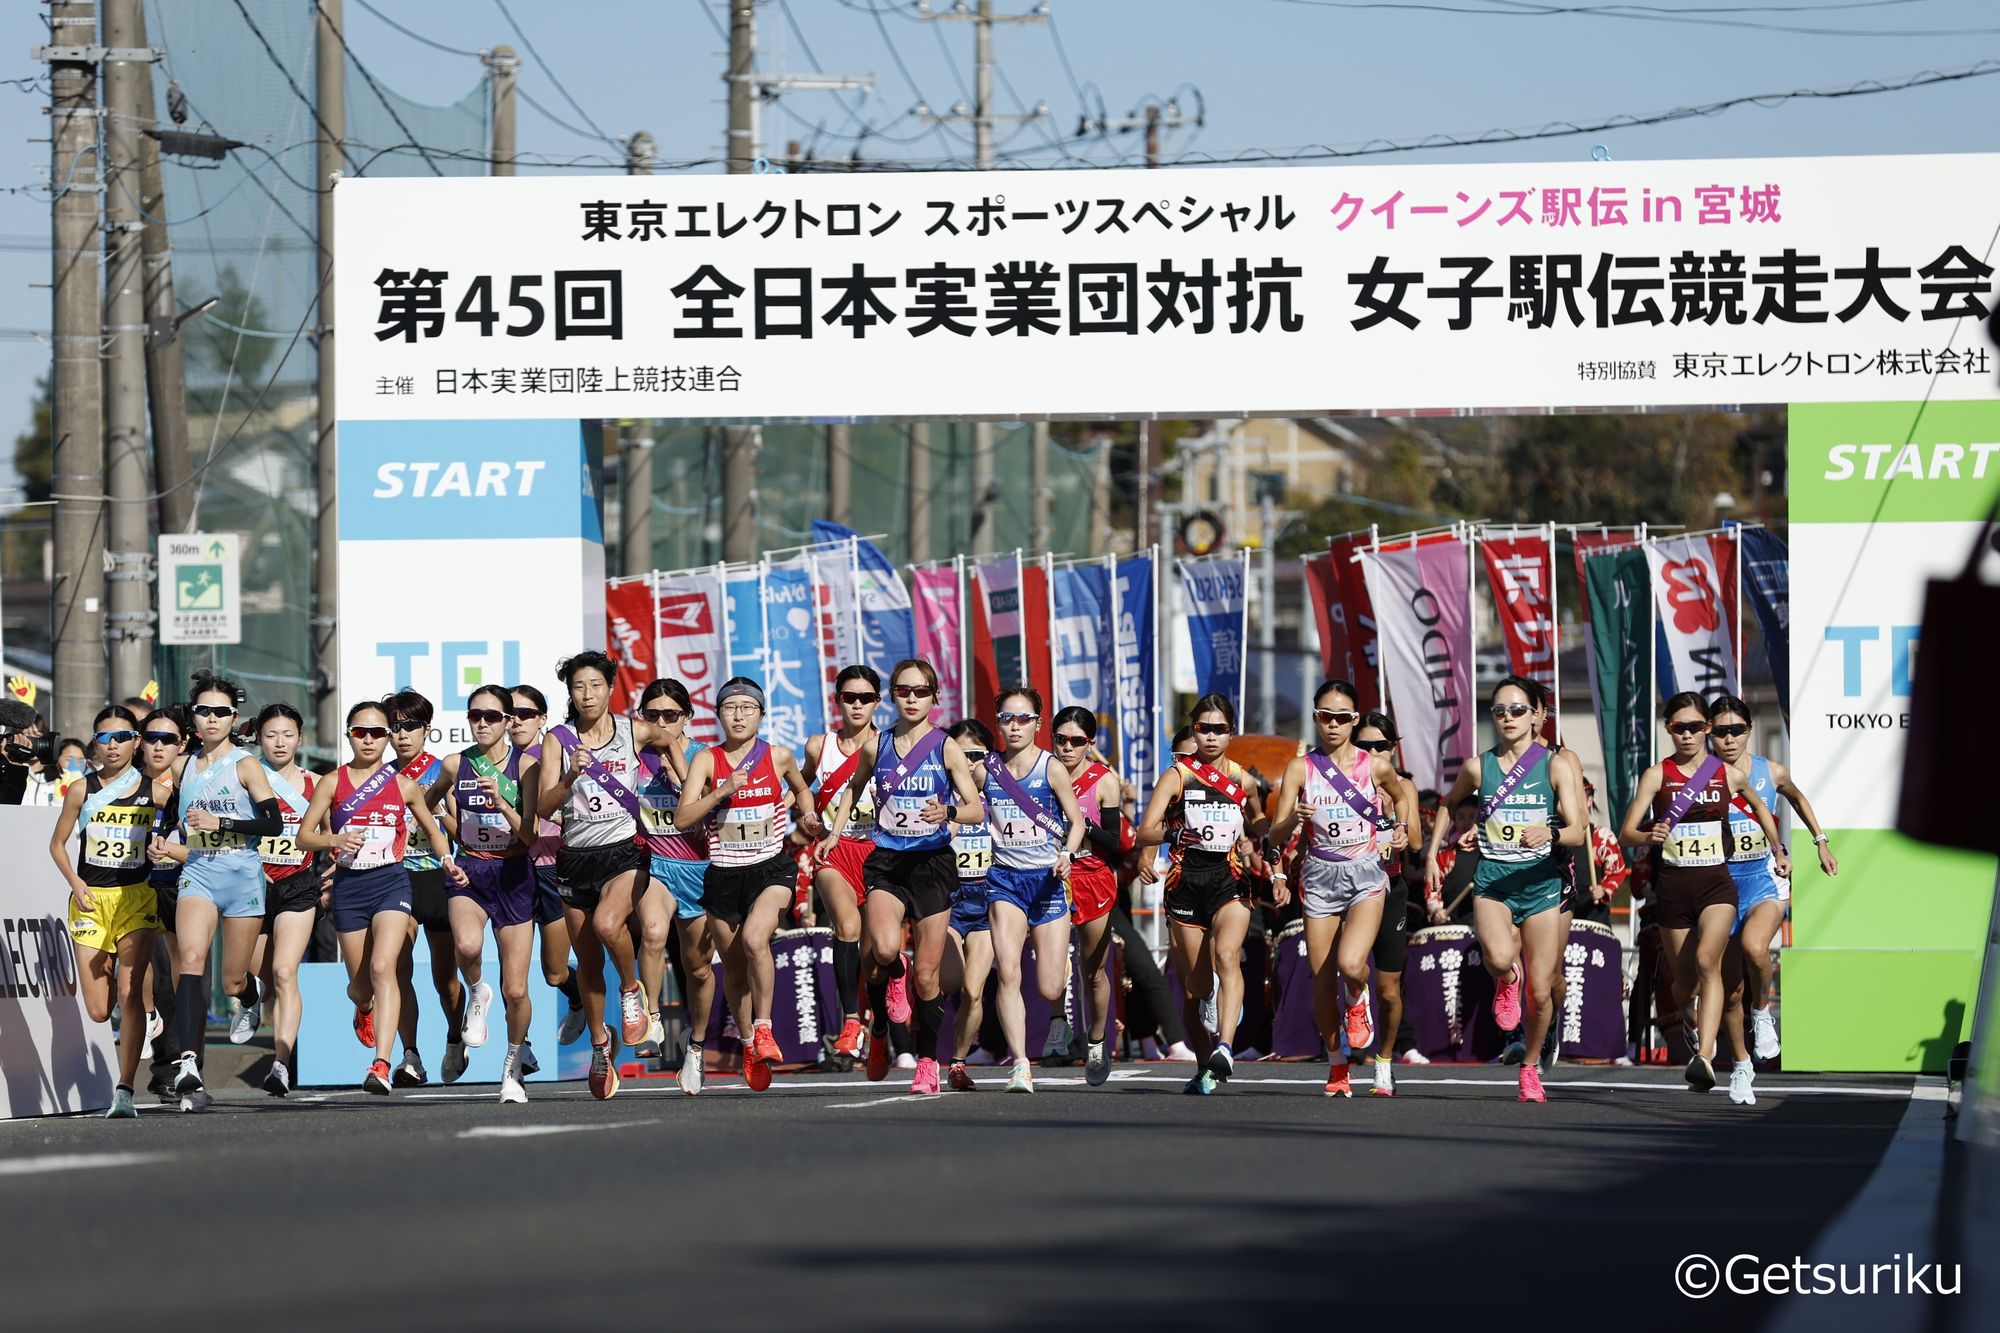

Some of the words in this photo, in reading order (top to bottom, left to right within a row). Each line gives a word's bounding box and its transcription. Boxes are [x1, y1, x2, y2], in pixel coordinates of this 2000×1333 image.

[581, 200, 901, 241] 東京エレクトロン
[925, 195, 1295, 236] スポーツスペシャル
[1331, 184, 1629, 231] クイーンズ駅伝
[1643, 188, 1681, 222] in
[1695, 184, 1781, 224] 宮城
[374, 268, 622, 343] 第45回
[670, 258, 1303, 339] 全日本実業団対抗
[1348, 246, 1994, 331] 女子駅伝競走大会
[1578, 361, 1656, 381] 特別協賛
[1673, 348, 1991, 380] 東京エレクトロン株式会社
[376, 376, 414, 395] 主催
[437, 366, 741, 393] 日本実業団陸上競技連合
[1825, 443, 2000, 480] START
[374, 461, 545, 498] START
[169, 544, 199, 555] 360m
[1825, 625, 1921, 696] TE
[1826, 713, 1893, 729] TOKYO
[898, 776, 933, 791] KISUI
[738, 787, 772, 800] 日本郵政
[1484, 794, 1546, 805] 住友海上
[187, 799, 235, 812] 後銀行
[894, 799, 921, 810] TEL
[1185, 801, 1238, 809] Iwatan
[345, 811, 397, 826] 一生命
[735, 808, 762, 820] TEL
[1204, 810, 1229, 822] TEL
[1327, 807, 1354, 819] TEL
[1503, 811, 1530, 822] TEL
[476, 815, 502, 826] TEL
[104, 826, 132, 840] TEL
[1678, 825, 1706, 837] TEL
[97, 840, 139, 859] 23-1
[962, 838, 987, 849] TEL
[1675, 840, 1716, 857] 14-1
[958, 852, 989, 869] 21-
[0, 917, 77, 998] LECTRO
